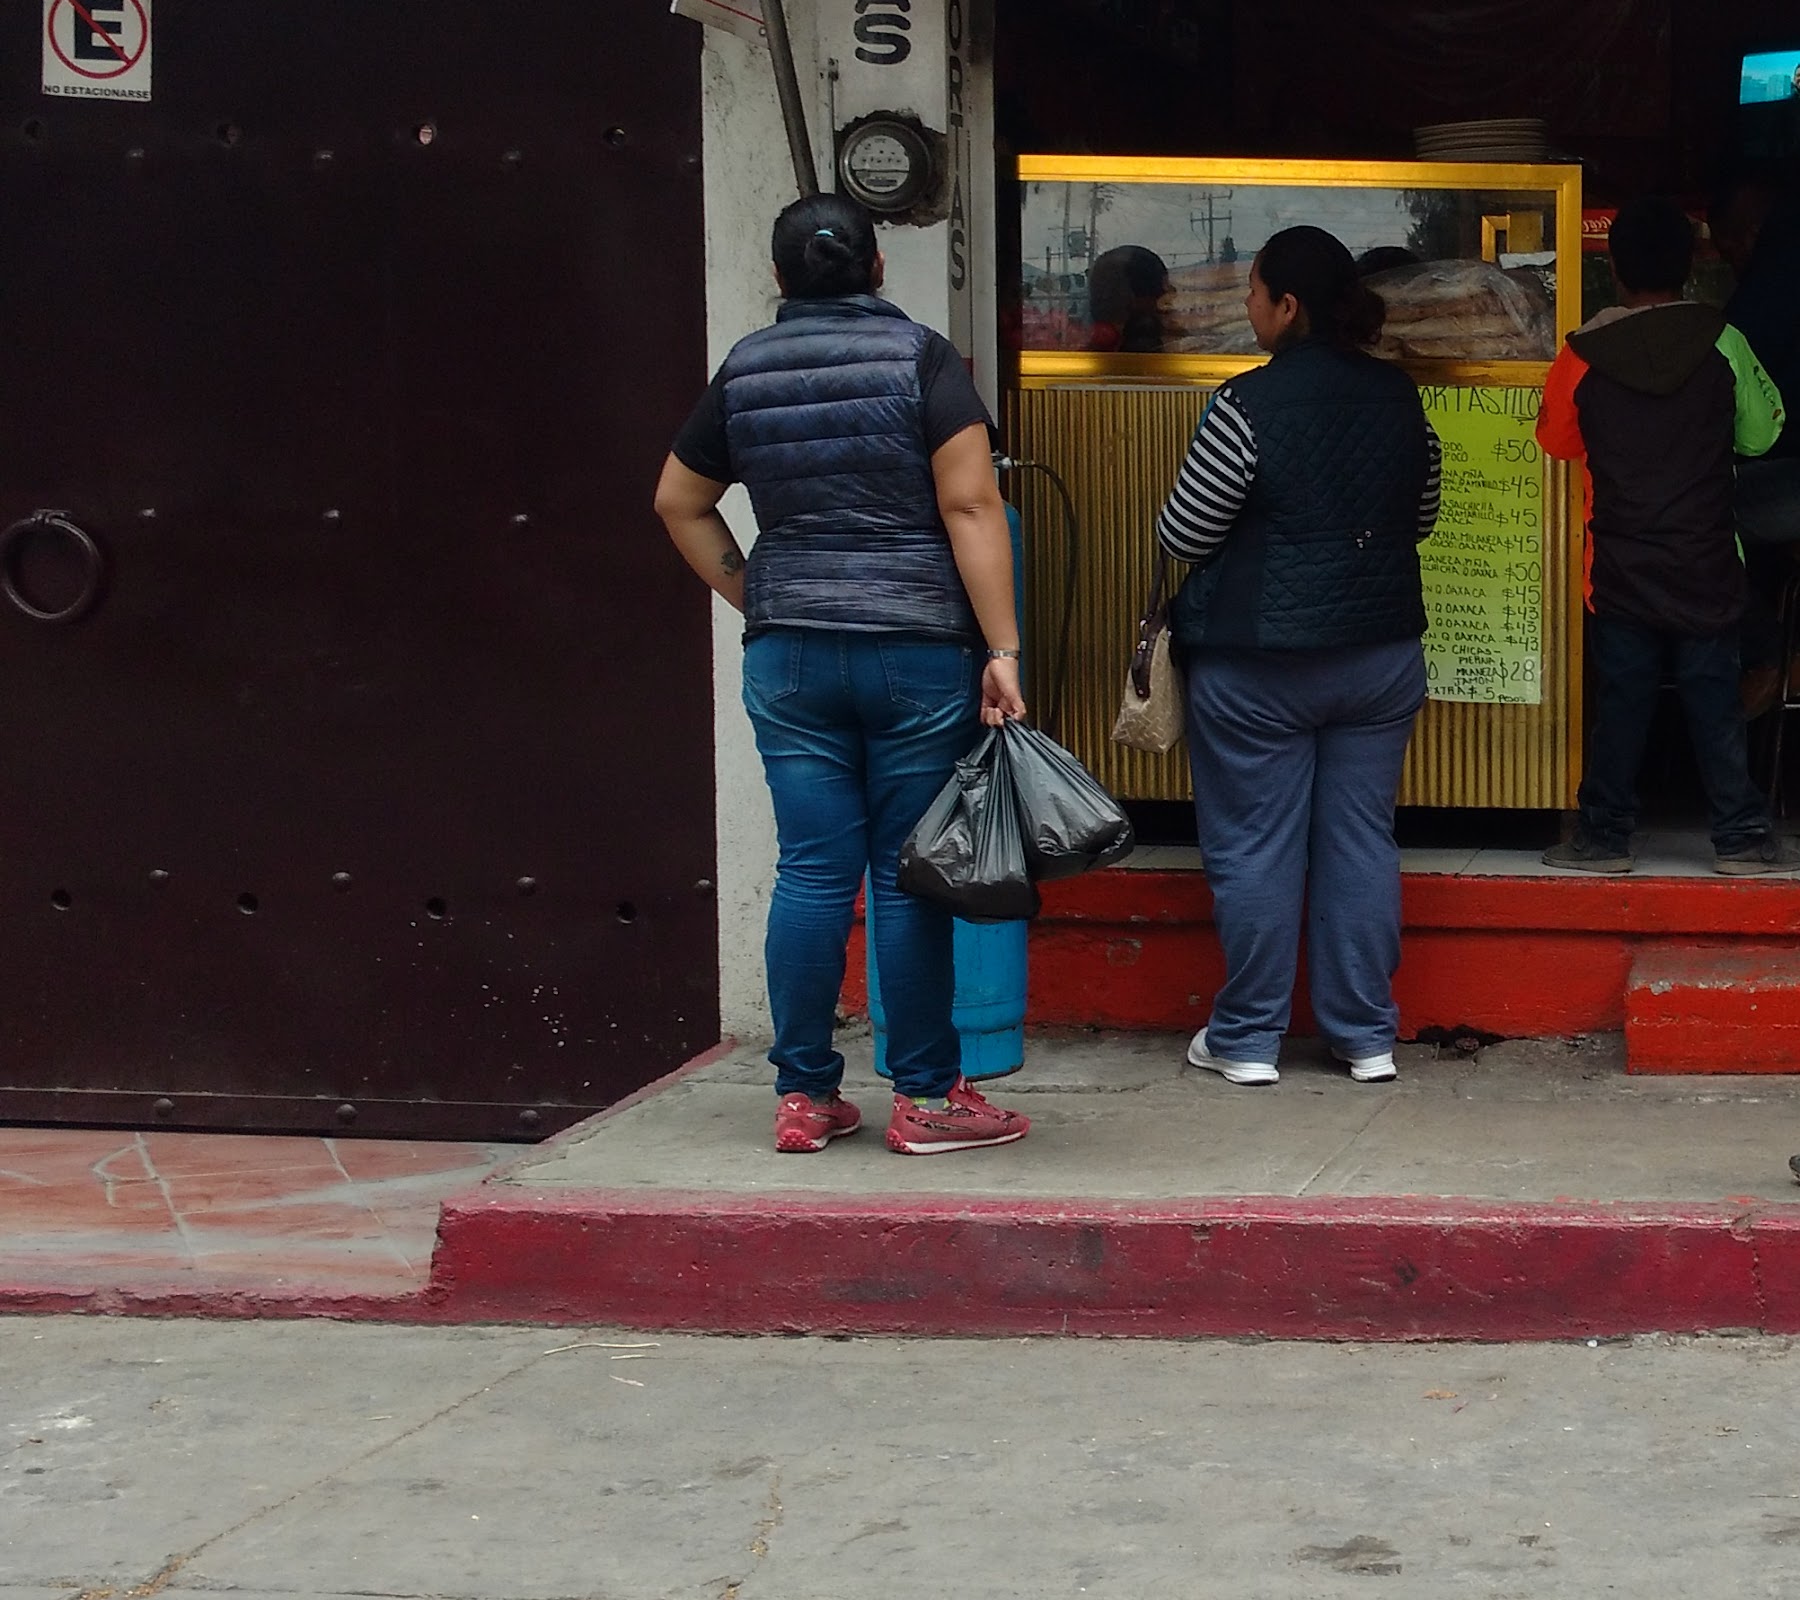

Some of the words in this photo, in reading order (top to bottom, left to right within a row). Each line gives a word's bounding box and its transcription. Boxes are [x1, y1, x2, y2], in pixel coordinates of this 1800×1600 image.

[44, 84, 60, 94] NO
[64, 85, 150, 99] ESTACIONARSE
[1418, 386, 1501, 415] ORTAS
[1491, 437, 1538, 463] $50
[1498, 475, 1540, 499] $45
[1494, 508, 1538, 528] $45
[1503, 534, 1540, 555] $45
[1504, 561, 1542, 583] $50
[1502, 585, 1541, 605] $45
[1502, 604, 1540, 622] $43
[1497, 657, 1535, 689] $28
